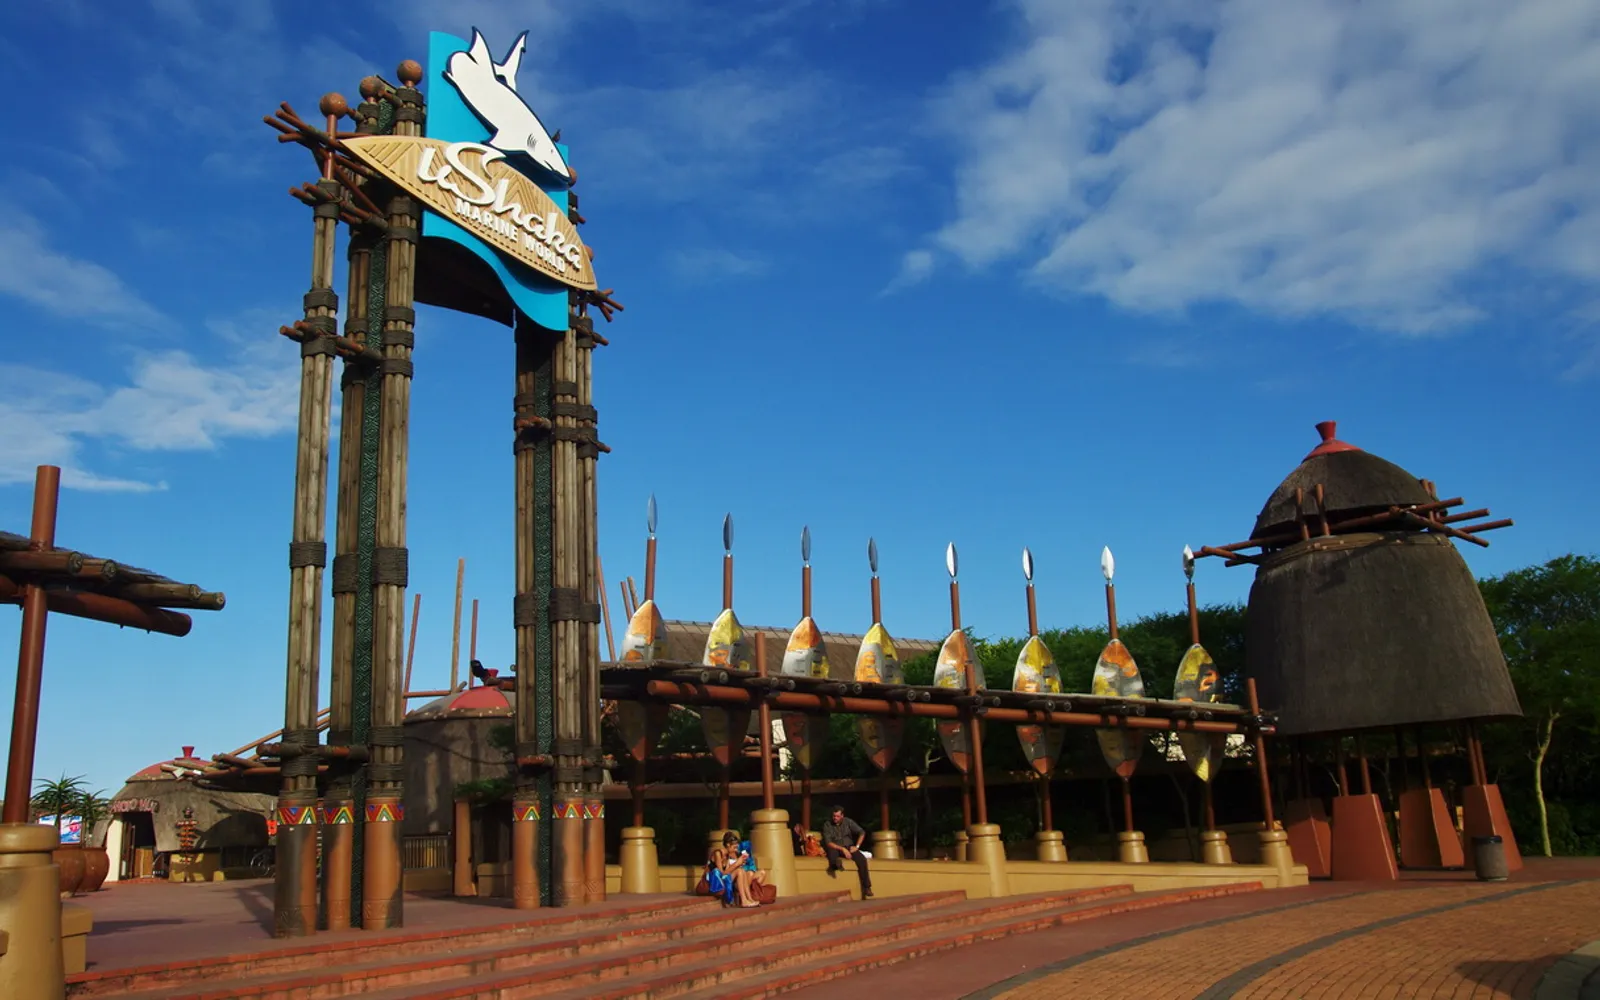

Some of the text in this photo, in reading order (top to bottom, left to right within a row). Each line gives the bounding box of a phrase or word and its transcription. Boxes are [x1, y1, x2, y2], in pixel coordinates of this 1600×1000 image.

[417, 142, 582, 270] uShaka
[455, 199, 566, 273] MARINE WORLD
